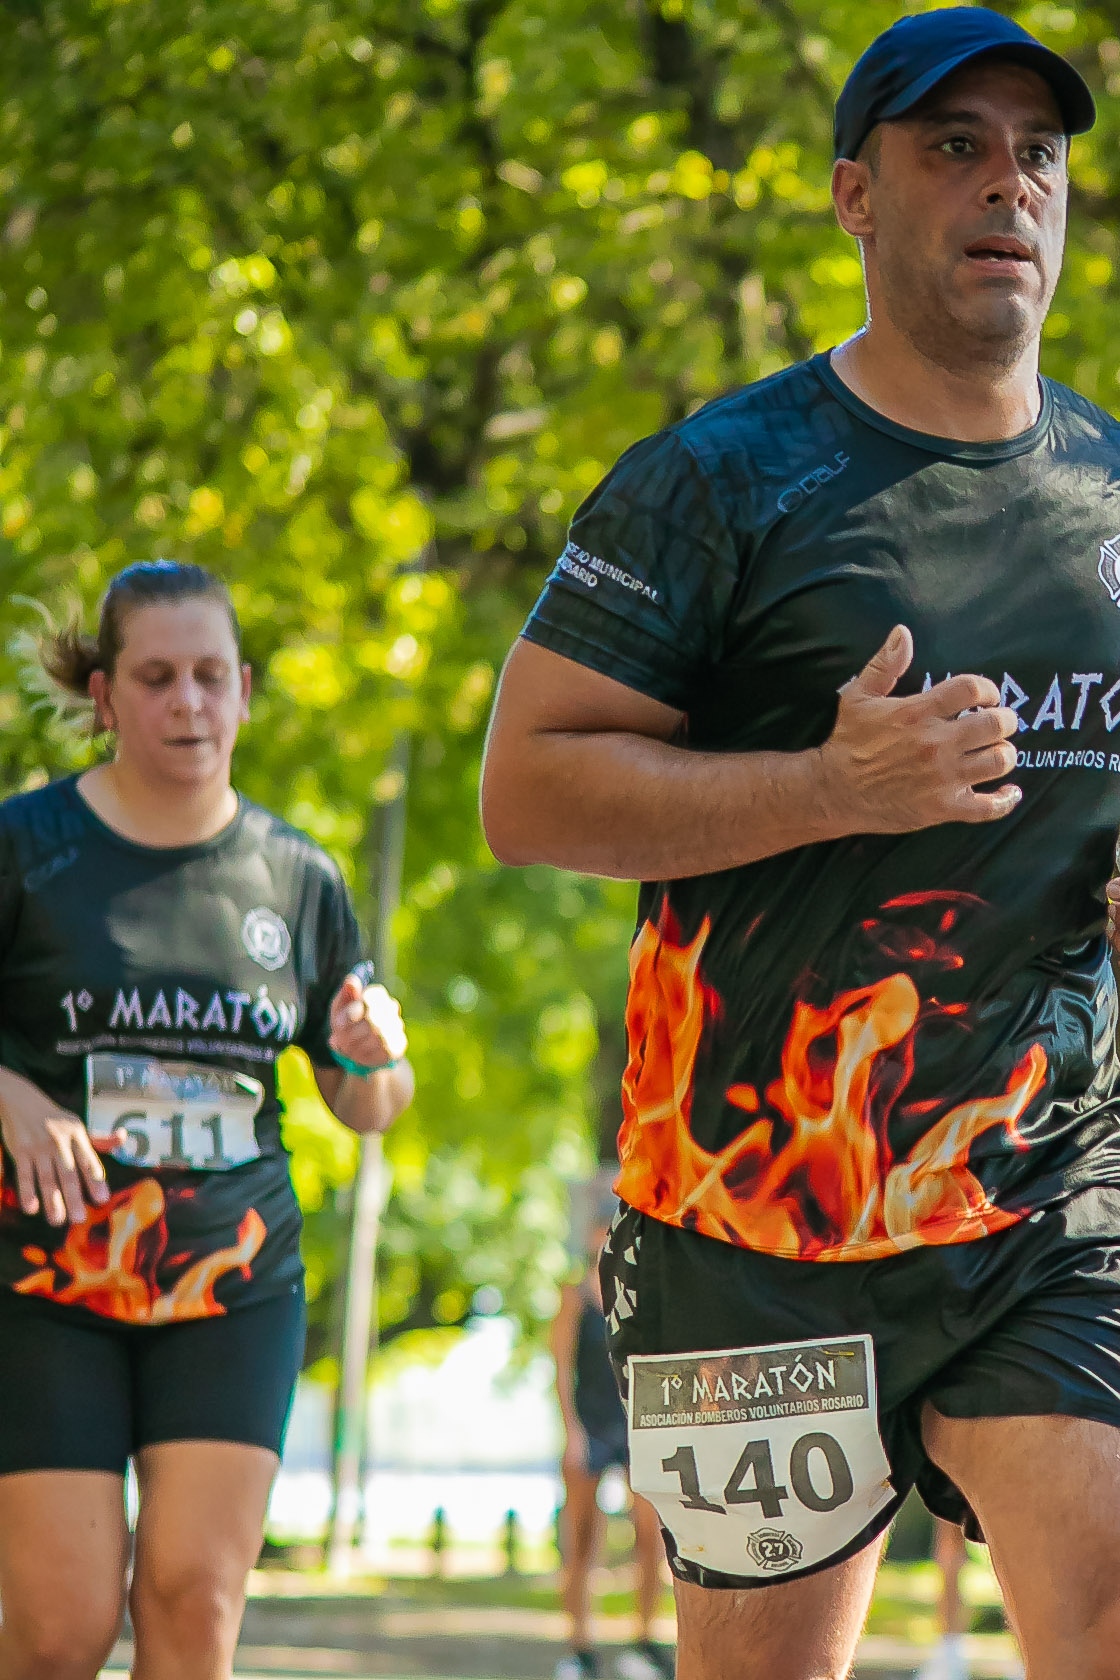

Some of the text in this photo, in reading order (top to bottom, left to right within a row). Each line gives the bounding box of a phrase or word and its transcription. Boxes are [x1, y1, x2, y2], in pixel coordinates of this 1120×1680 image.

[588, 556, 658, 601] MUNICIPAL
[1015, 749, 1106, 769] OLUNTARIOS
[108, 983, 298, 1042] MARATÓN
[692, 1354, 837, 1404] MARATÓN
[695, 1407, 748, 1424] BOMBEROS
[749, 1399, 820, 1420] VOLUNTARIOS
[822, 1394, 865, 1411] ROSARIO
[661, 1431, 854, 1519] 140
[761, 1541, 785, 1558] 27
